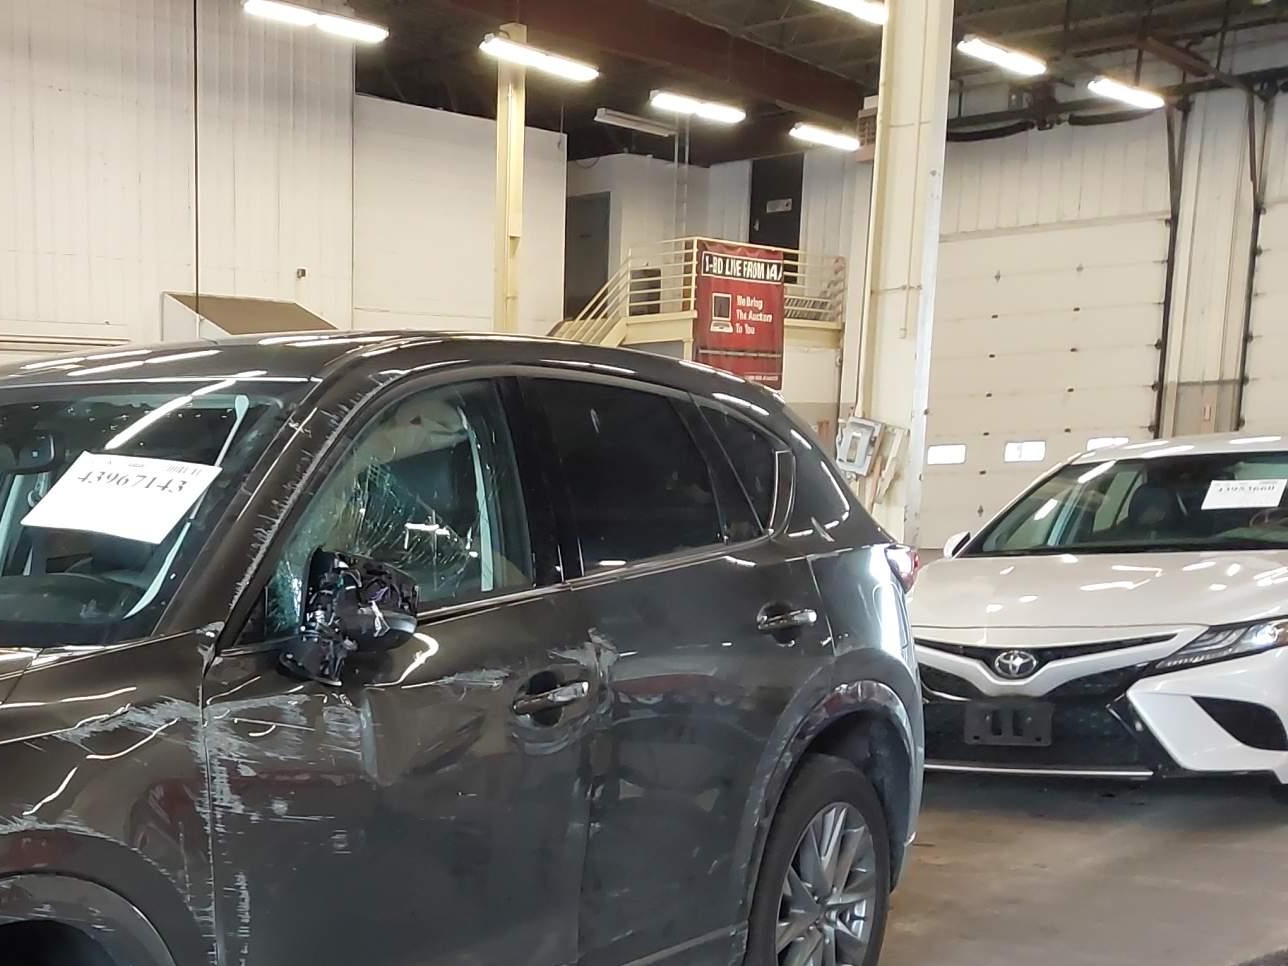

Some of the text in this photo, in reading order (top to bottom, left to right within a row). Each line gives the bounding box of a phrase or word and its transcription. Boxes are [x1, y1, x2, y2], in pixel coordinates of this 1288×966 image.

[725, 258, 742, 277] LIVE
[743, 261, 765, 280] FROM
[736, 295, 763, 310] We Bring
[736, 309, 773, 323] The Auction
[735, 322, 756, 335] To You
[77, 471, 188, 493] 43967143
